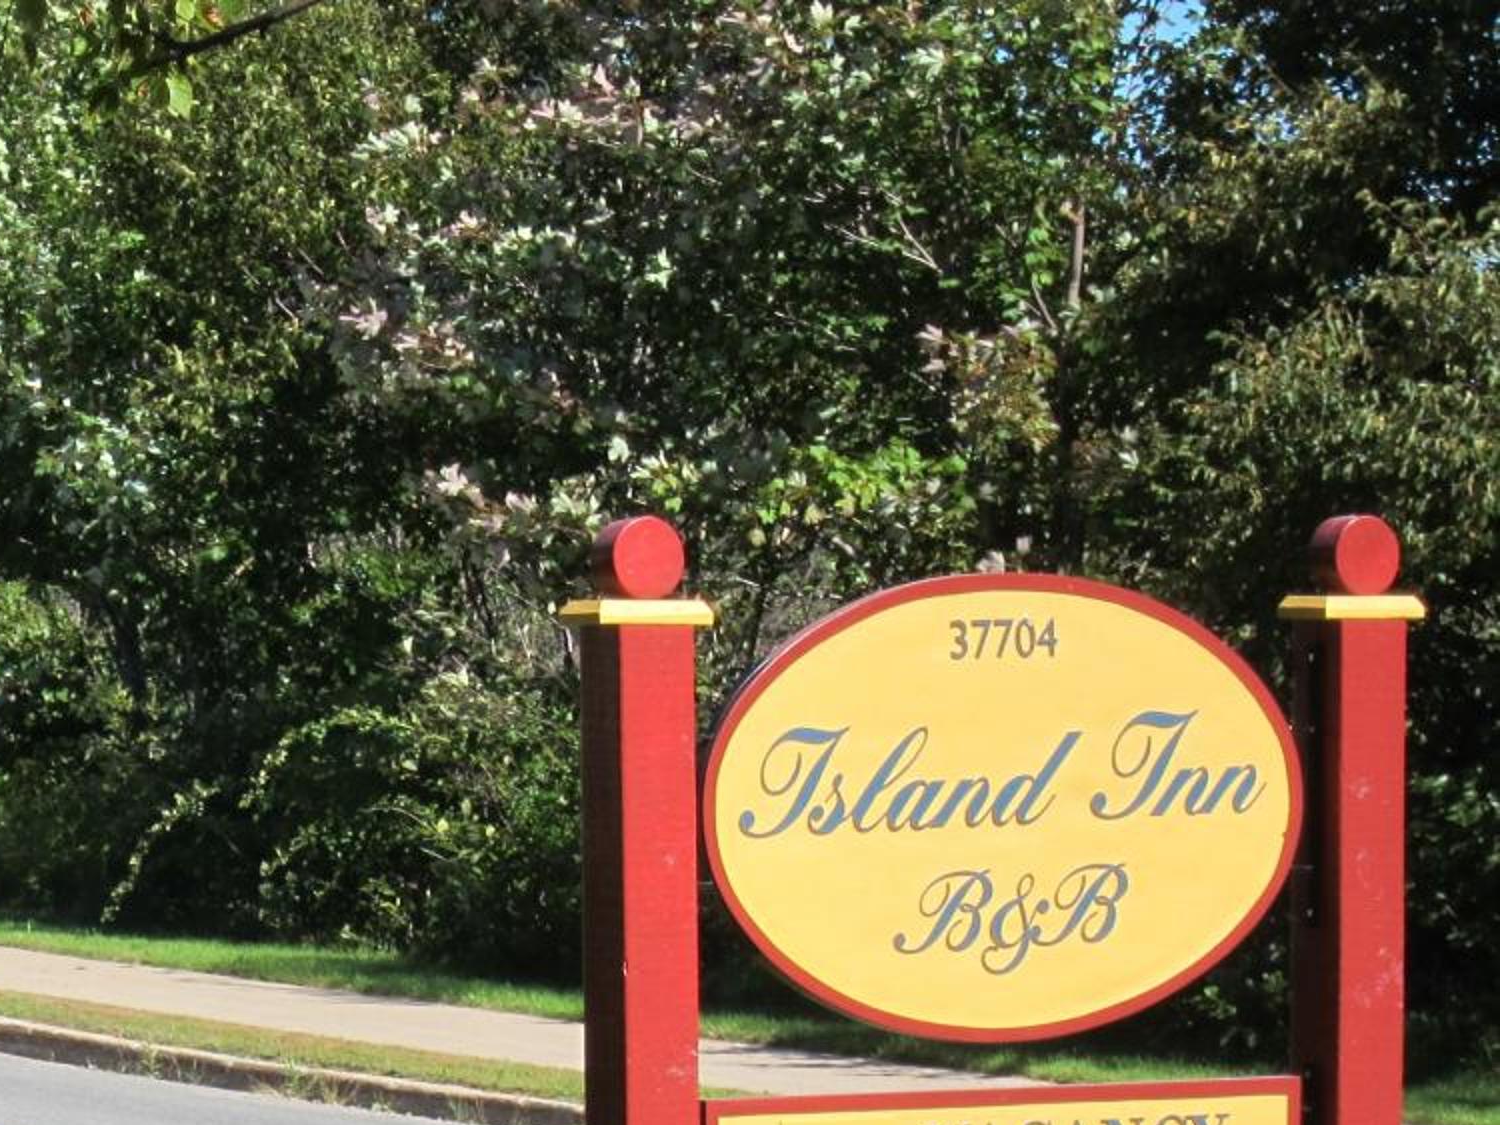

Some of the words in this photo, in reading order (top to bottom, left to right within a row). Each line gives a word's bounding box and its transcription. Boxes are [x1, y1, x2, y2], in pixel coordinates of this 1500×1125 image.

[949, 618, 1058, 661] 37704
[737, 725, 1083, 840] Island
[1089, 709, 1267, 820] Inn
[892, 862, 1130, 976] B&B
